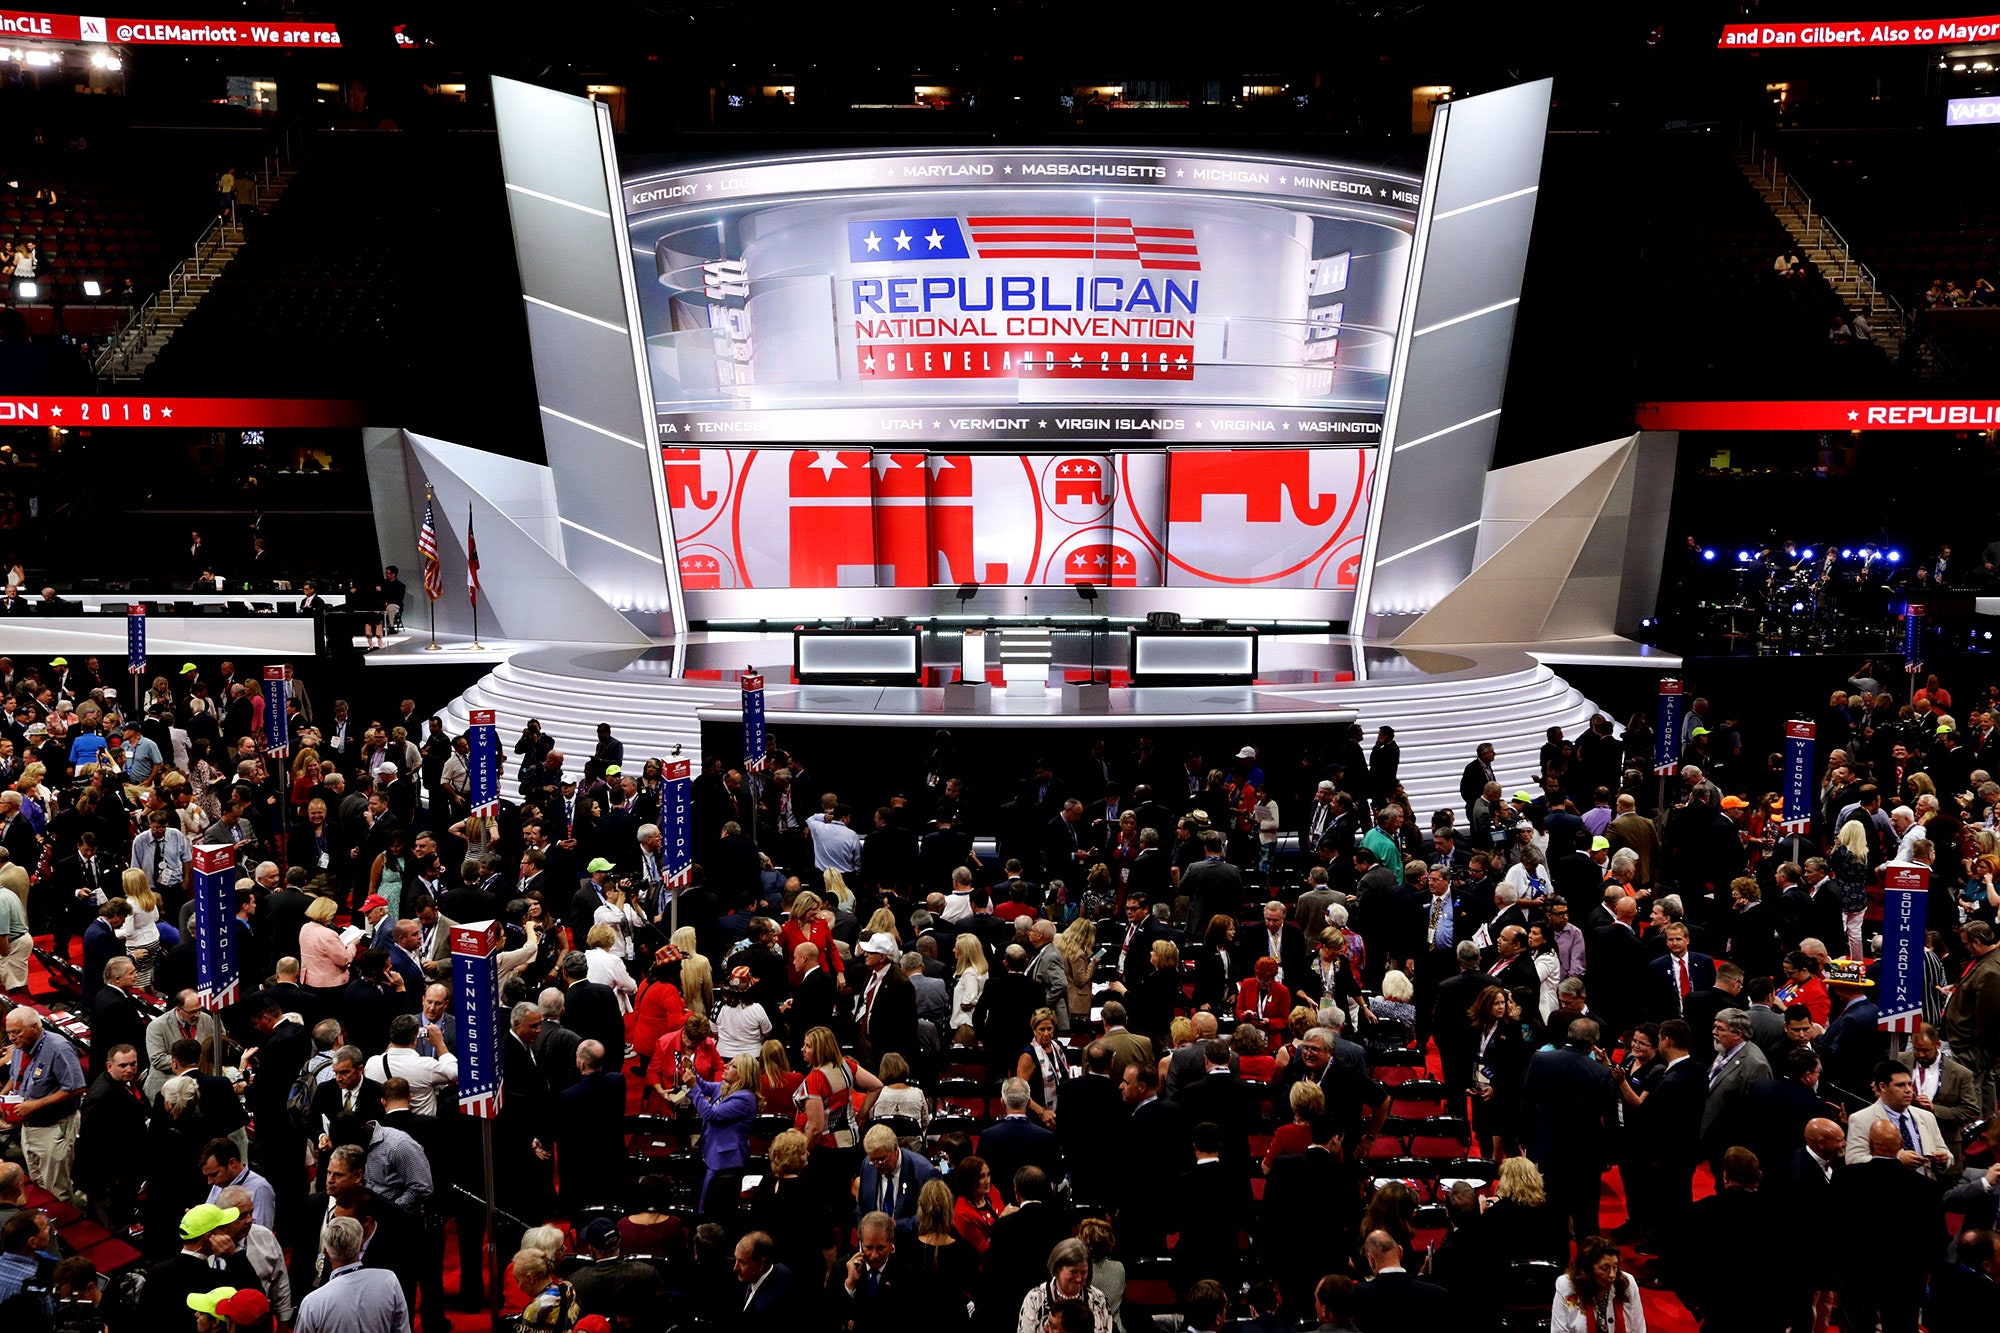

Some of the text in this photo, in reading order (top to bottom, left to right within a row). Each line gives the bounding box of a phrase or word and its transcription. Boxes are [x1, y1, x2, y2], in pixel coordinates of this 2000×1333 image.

[0, 15, 51, 34] inCLE
[117, 25, 236, 41] @CLEMarriott
[251, 27, 280, 42] We
[286, 31, 310, 42] are
[314, 32, 340, 43] rea
[1726, 24, 2000, 44] and Dan Gilbert. Also to Mayor
[632, 184, 699, 204] KENTUCKY
[902, 164, 994, 177] MARYLAND
[1022, 164, 1166, 177] MASSACHUSETTS
[1193, 168, 1269, 184] MICHIGAN
[1293, 175, 1373, 196] MINNESOTA
[1392, 189, 1420, 205] MISS
[852, 276, 1199, 315] REPUBLICAN
[856, 317, 1194, 339] NATIONAL CONVENTION
[886, 351, 1170, 373] CLEVELAND 2016
[82, 403, 150, 420] 2016
[881, 419, 922, 430] UTAH
[949, 418, 1028, 430] VERMONT
[1055, 418, 1111, 430] VIRGIN
[1116, 418, 1186, 431] ISLANDS
[1210, 419, 1275, 431] VIRGINIA
[1298, 421, 1382, 434] WASHINGTON
[271, 681, 279, 742] CONNECTICUT
[1663, 696, 1674, 759] CALIFORNIA
[479, 726, 487, 747] NEW
[1793, 741, 1805, 811] WISCONSIN
[676, 783, 685, 858] FLORIDA
[199, 877, 207, 975] ILLINOIS
[219, 876, 229, 973] ILLINOIS
[1900, 892, 1911, 931] SOUTH
[1896, 940, 1909, 1001] CAROLINA
[464, 959, 480, 1081] TENNESSEE
